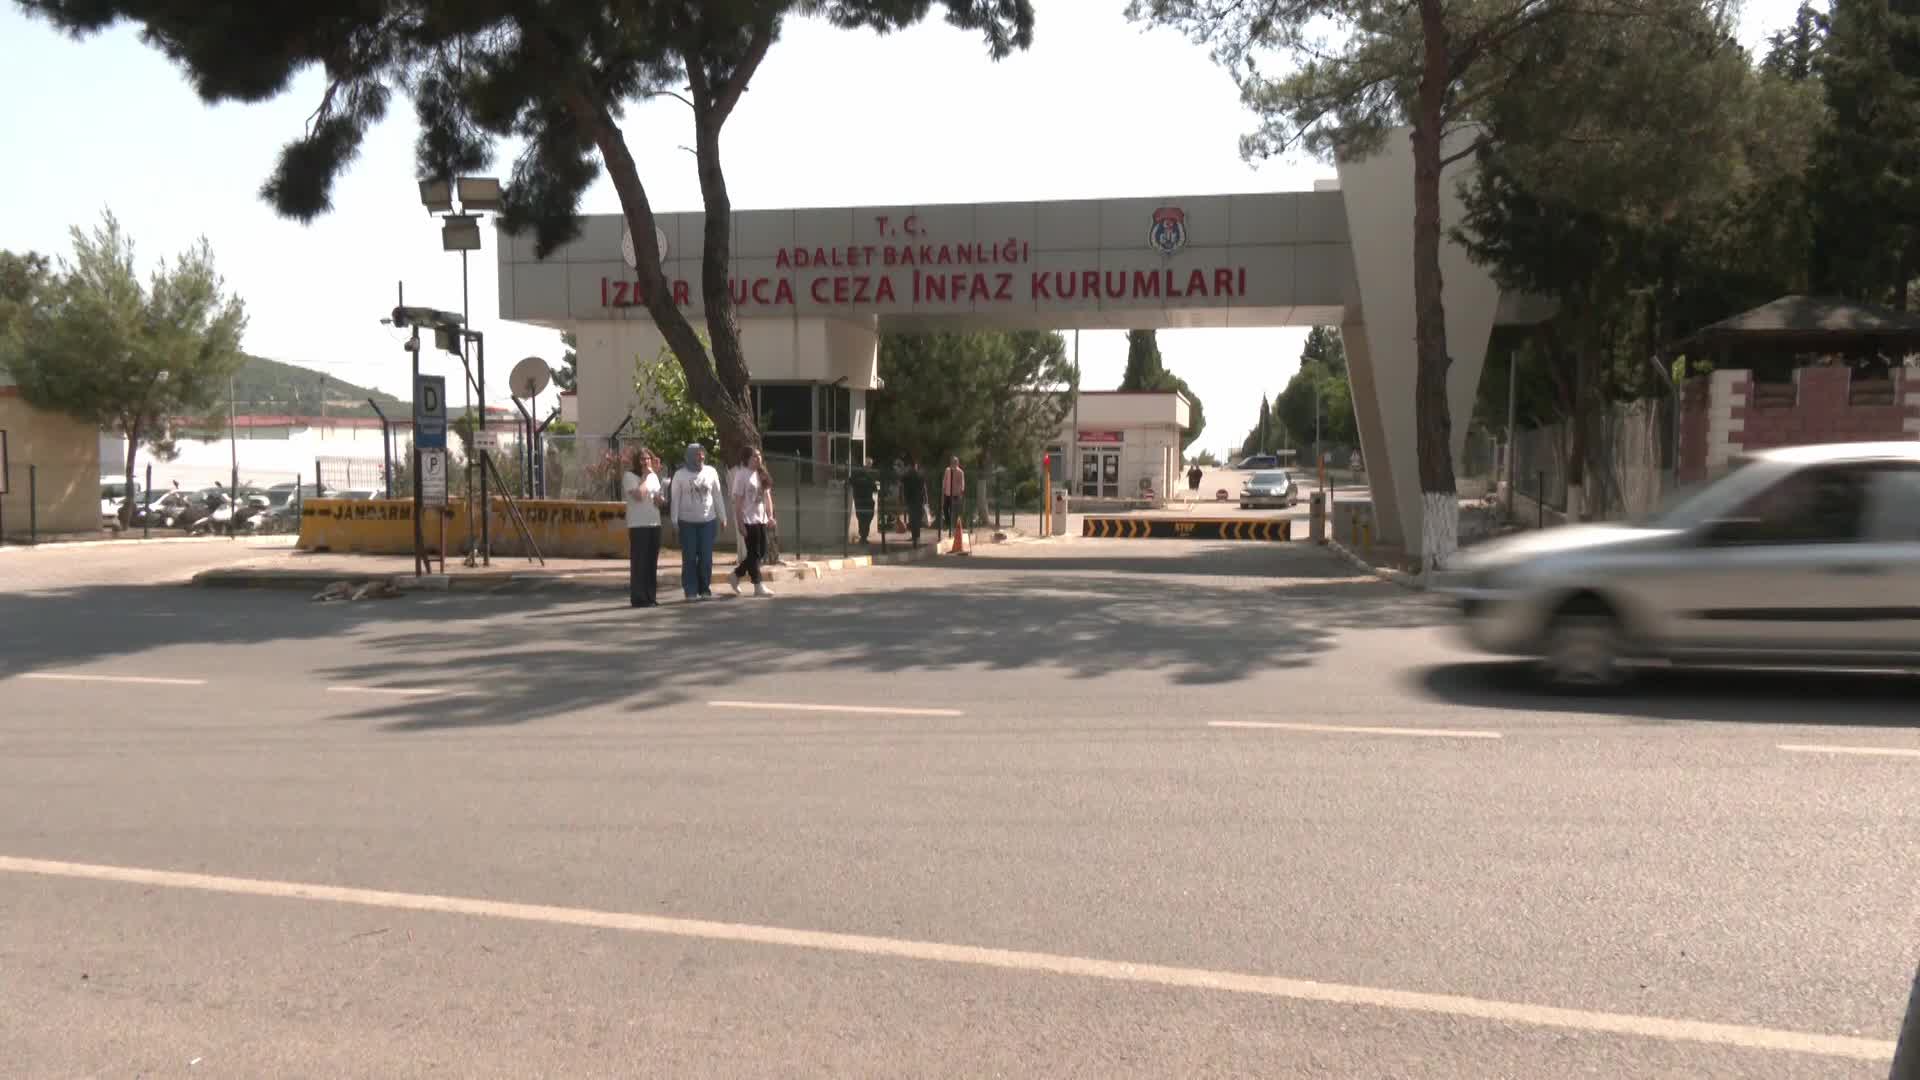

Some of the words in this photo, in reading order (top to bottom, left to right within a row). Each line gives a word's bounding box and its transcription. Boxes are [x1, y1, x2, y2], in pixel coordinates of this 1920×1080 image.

[776, 246, 876, 269] ADALET
[884, 237, 1028, 264] BAKANLIĞI
[726, 277, 795, 304] UCA
[811, 274, 895, 304] CEZA
[913, 270, 1013, 303] İNFAZ
[1031, 267, 1246, 300] KURUMLARI
[424, 386, 437, 411] D
